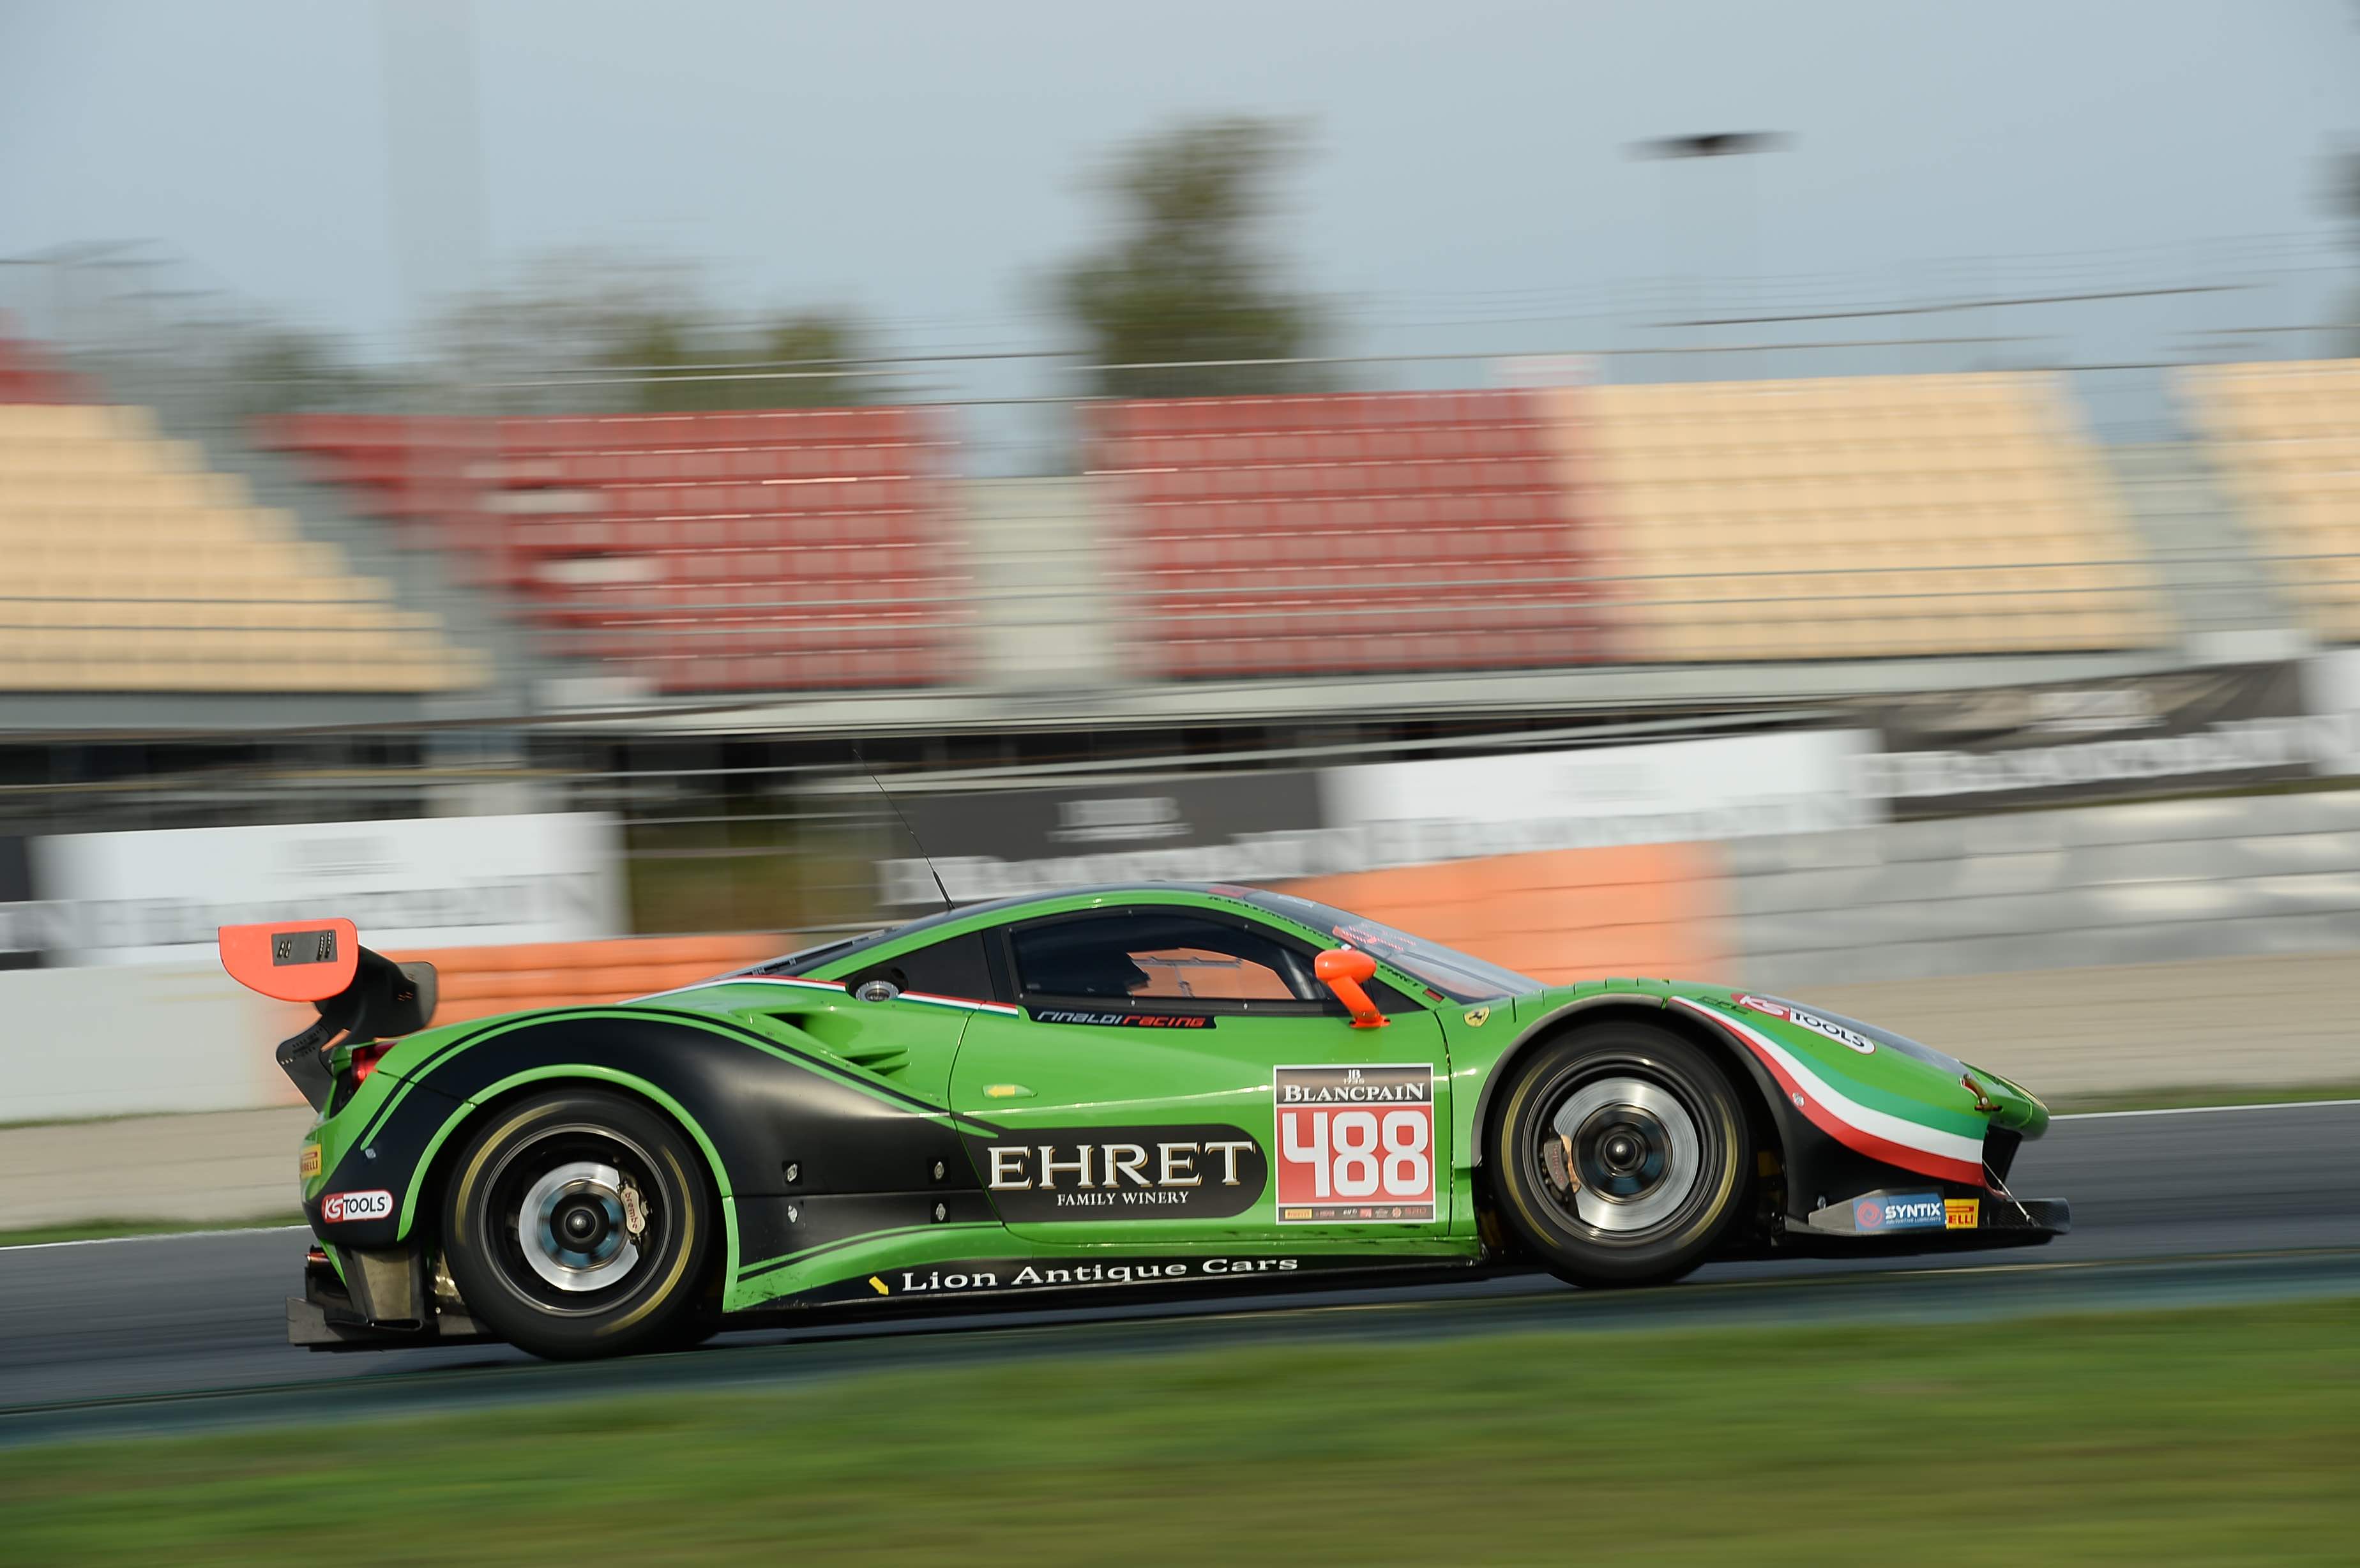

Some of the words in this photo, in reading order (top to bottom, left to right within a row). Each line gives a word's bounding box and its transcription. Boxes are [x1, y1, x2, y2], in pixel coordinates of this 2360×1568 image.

[1793, 1011, 1866, 1048] TOOLS
[1283, 1083, 1425, 1103] BLANCPAIN
[987, 1142, 1257, 1191] EHRET
[1282, 1110, 1430, 1198] 488
[343, 1196, 386, 1215] TOOLS
[624, 1192, 639, 1230] brembo
[1057, 1193, 1117, 1207] FAMILY
[1122, 1191, 1190, 1205] WINERY
[1885, 1202, 1942, 1219] SYNTIX
[902, 1272, 999, 1292] Lion
[1011, 1261, 1188, 1286] Antique
[1202, 1257, 1299, 1274] Cars
